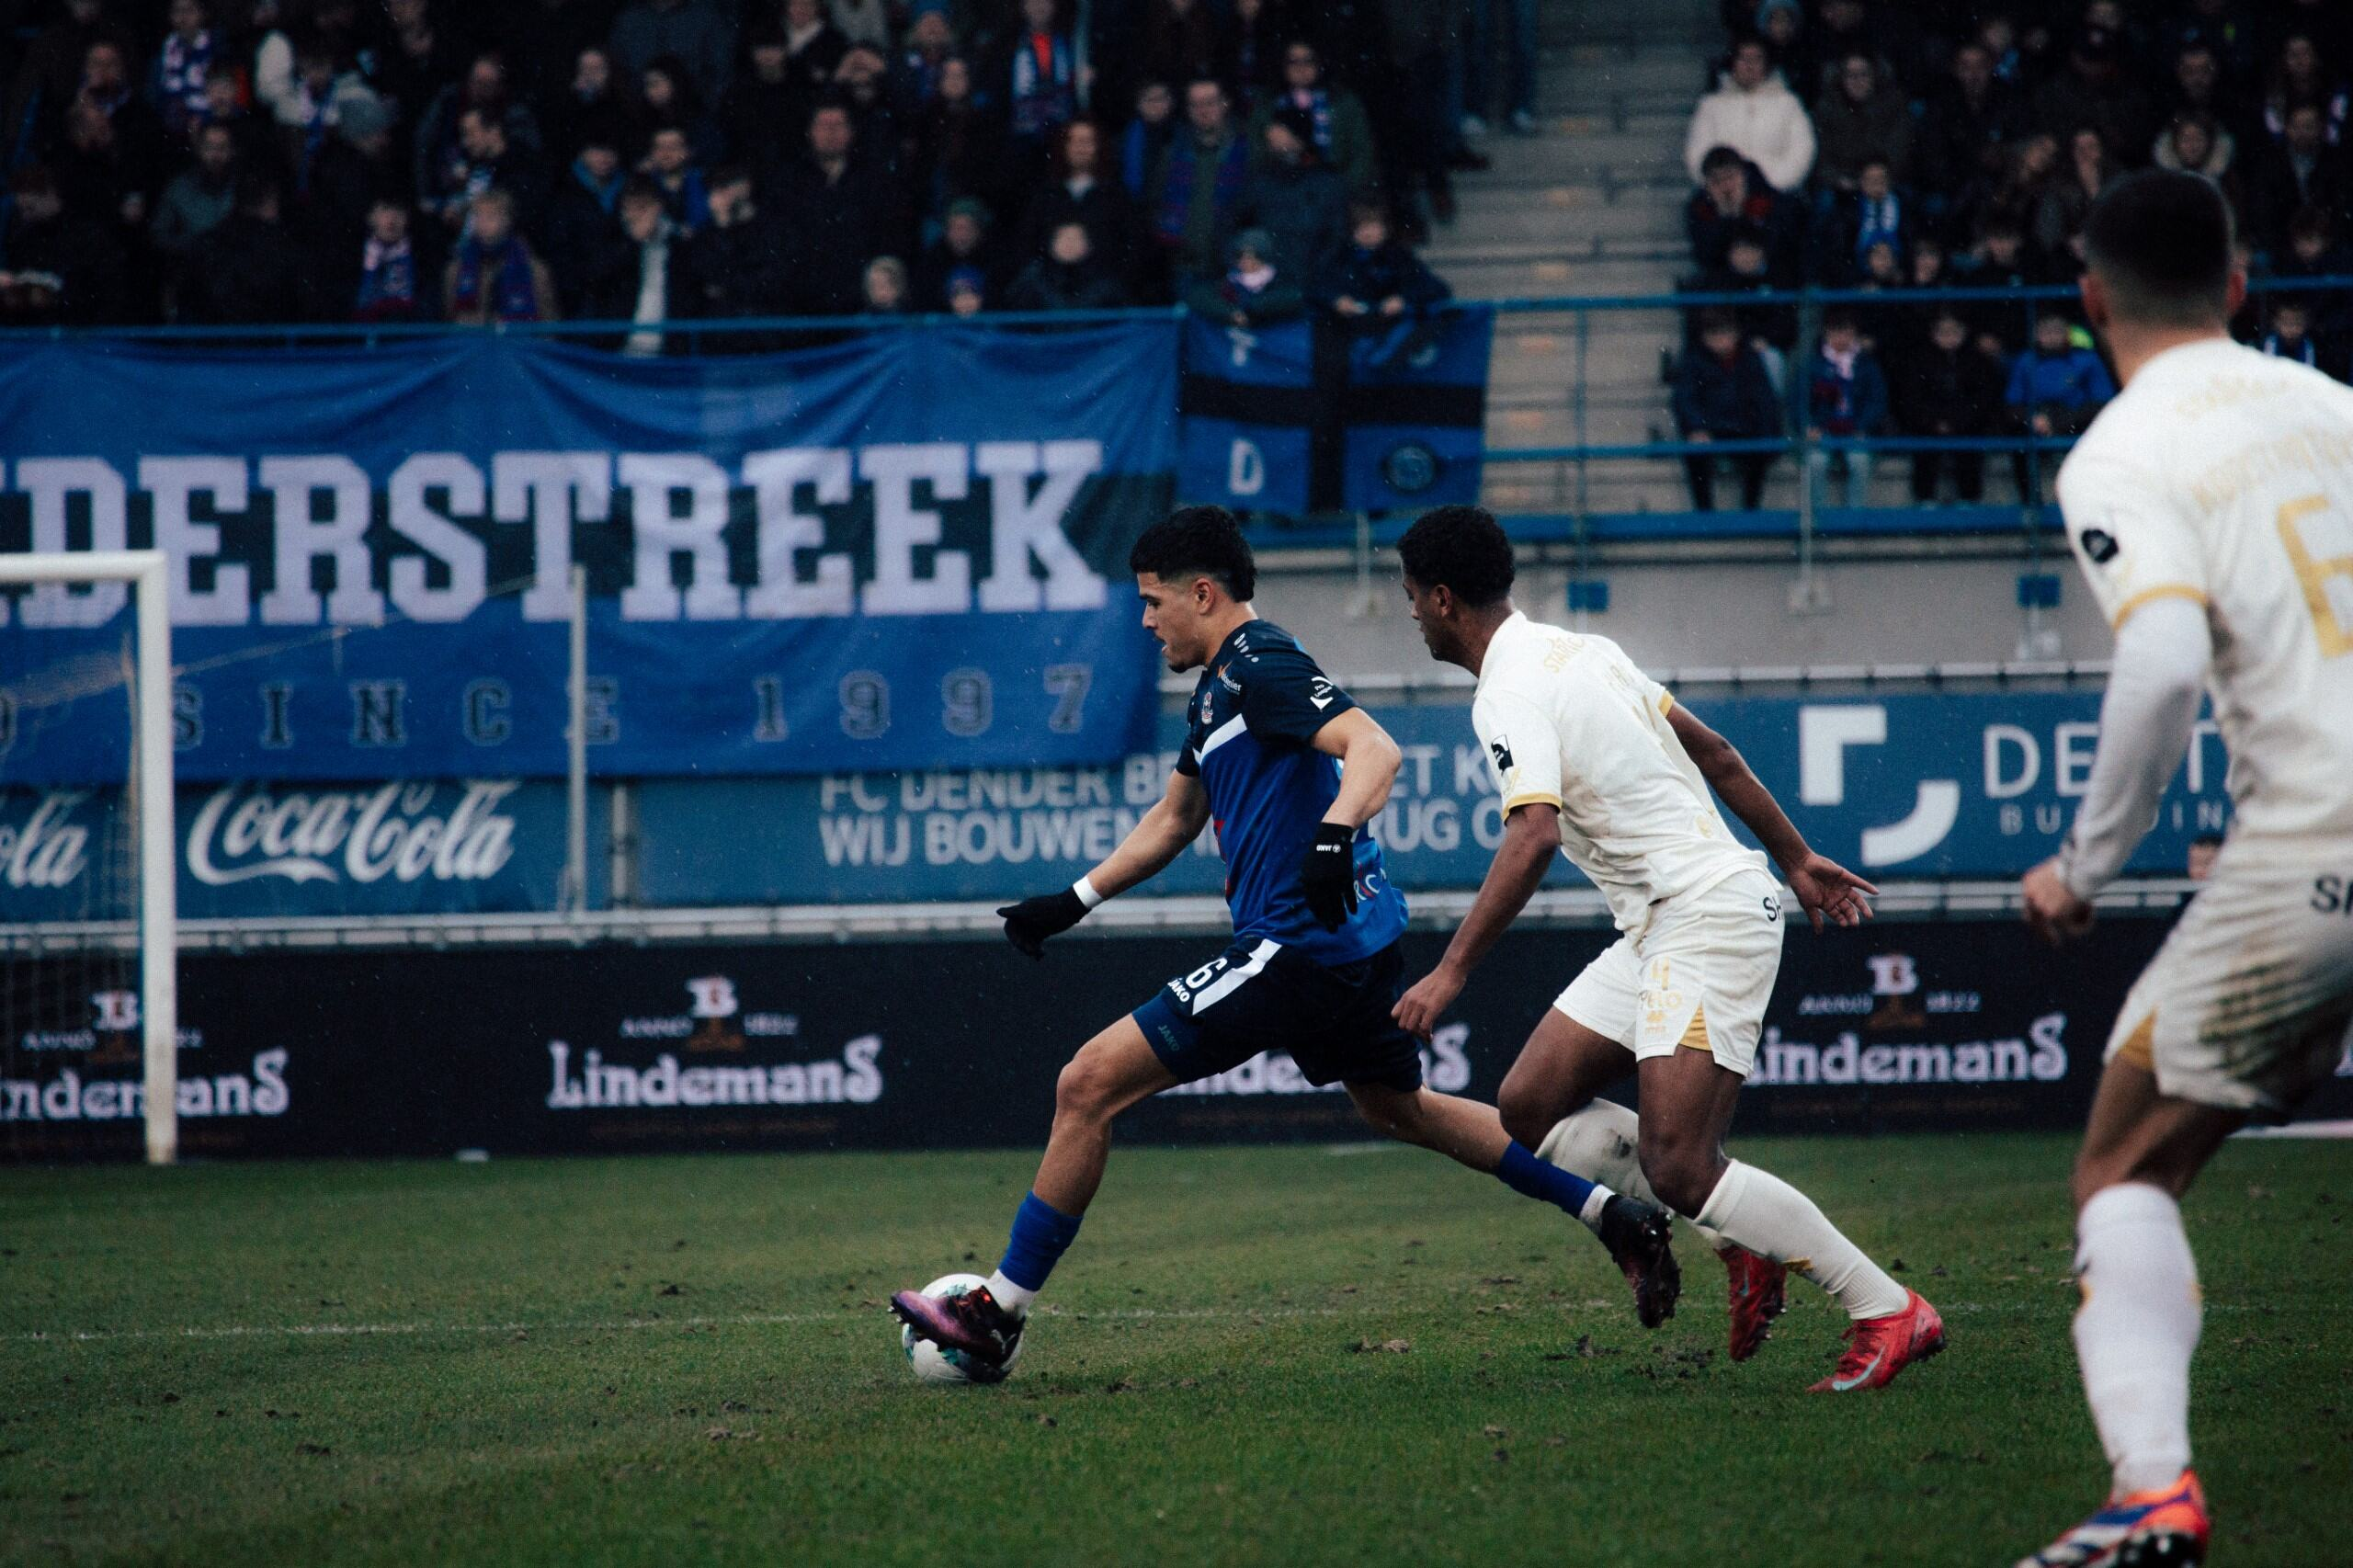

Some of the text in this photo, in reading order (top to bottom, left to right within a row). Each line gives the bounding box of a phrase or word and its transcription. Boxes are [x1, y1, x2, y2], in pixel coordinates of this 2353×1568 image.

[0, 439, 1107, 629] DERSTREEK
[172, 663, 1093, 749] SINCE 1997
[820, 775, 890, 812] FC
[901, 767, 1112, 812] DENDER
[819, 812, 911, 867] WIJ
[1166, 978, 1190, 1004] JAKO
[1185, 957, 1228, 989] 6
